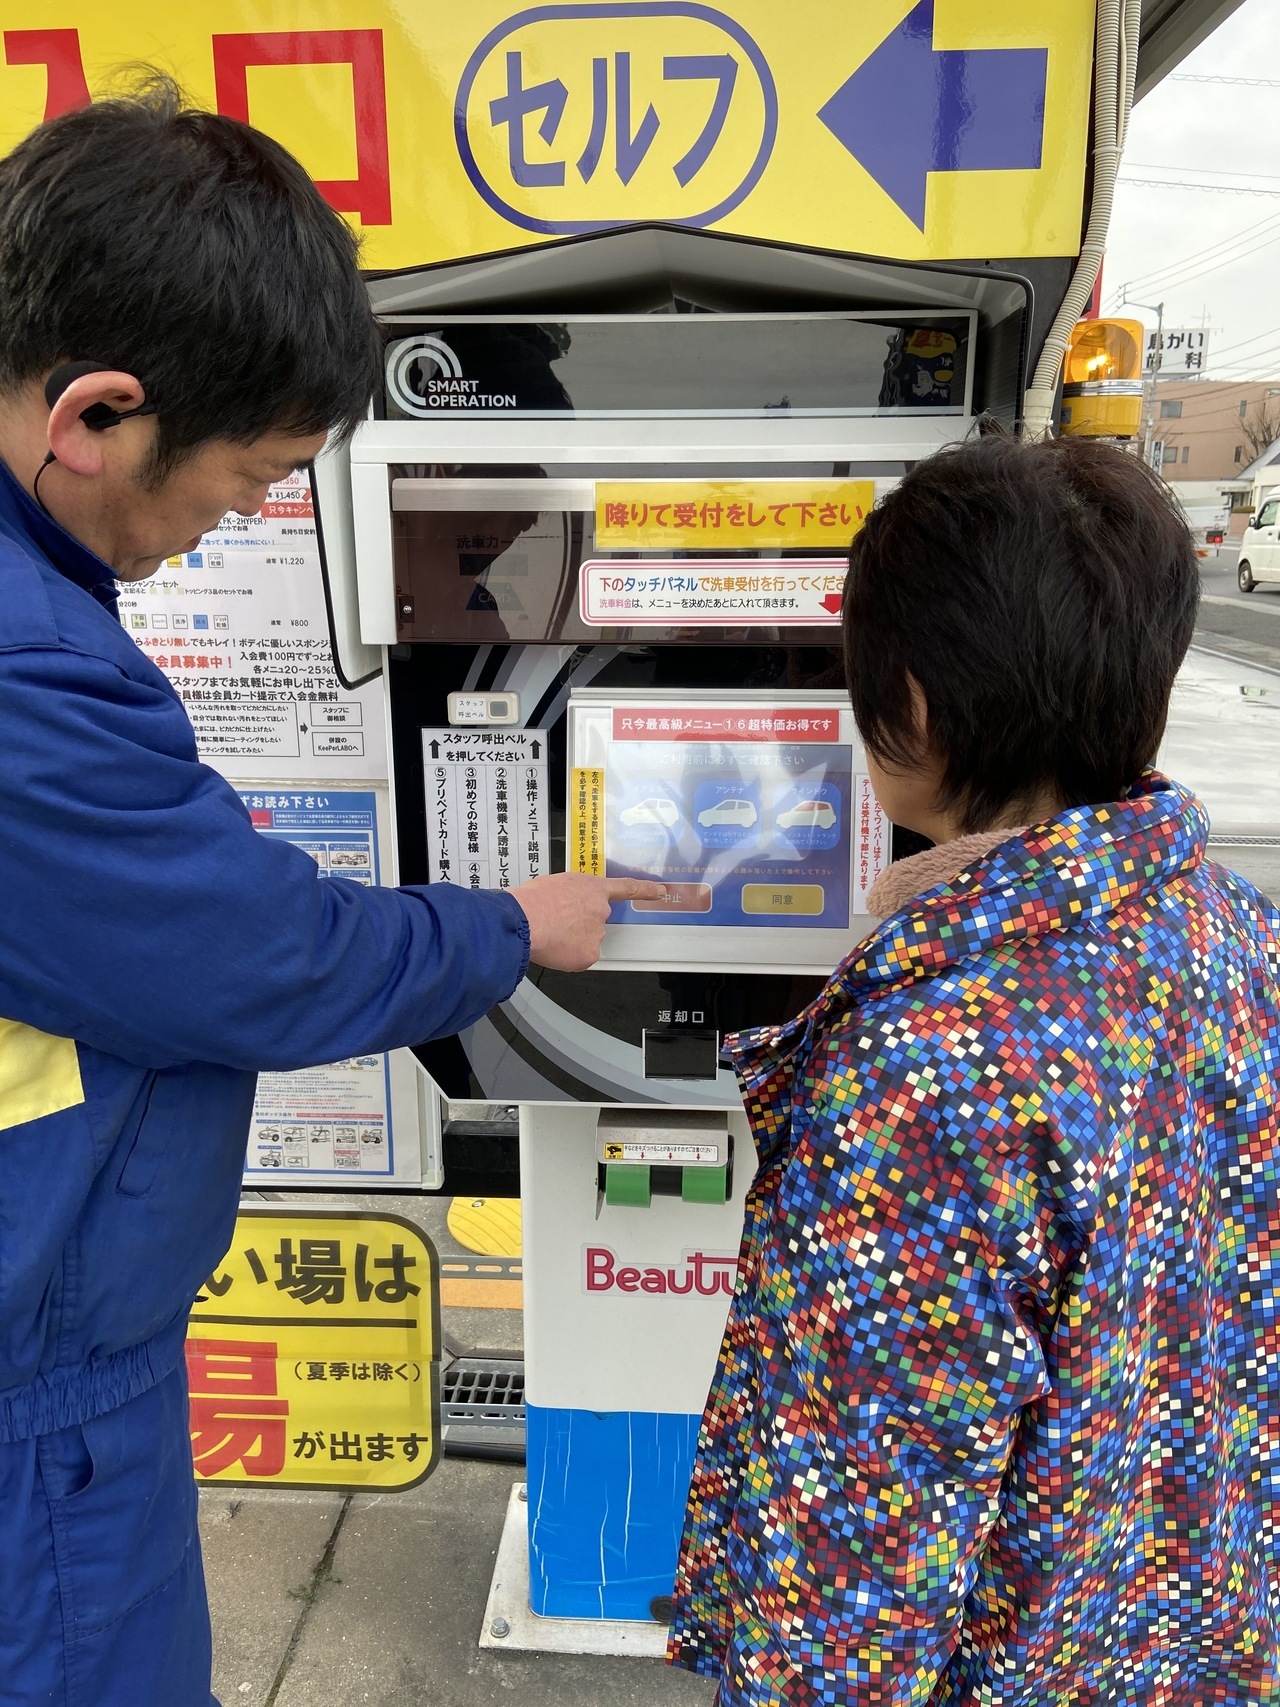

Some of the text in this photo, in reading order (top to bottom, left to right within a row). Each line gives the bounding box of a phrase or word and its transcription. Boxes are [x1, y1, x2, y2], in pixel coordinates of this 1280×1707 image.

[490, 51, 739, 188] セルフ
[428, 381, 479, 393] SMART
[428, 395, 517, 407] OPERATION
[605, 502, 863, 529] 降りて受付をして下さい
[478, 592, 511, 604] CARD
[599, 598, 800, 608] 洗車料金は、メニューを決めたあとに入れて頂きます。
[135, 637, 333, 648] らふきとり無しでもキレイ！ボディに優しいスポンジ
[147, 654, 232, 669] 会員募集中！
[443, 733, 527, 745] スタッフ呼出ベル
[446, 750, 526, 761] を押してください
[715, 786, 745, 794] アンテナ
[465, 767, 480, 853] ③初めてのお客様
[434, 767, 451, 883] ⑤プリペイドカード購入
[494, 767, 511, 891] ②洗車機乗入誘導してほ
[578, 771, 587, 874] を必ず確認の上、同意ボタンを押し
[591, 771, 599, 876] 左の「洗車をする前に必ずお読み下
[860, 779, 870, 891] テープは受付機下部にあります
[873, 797, 883, 883] たてワイパーはテープ
[772, 894, 793, 905] 同意
[657, 1010, 704, 1023] 返却口
[294, 1361, 421, 1382] （夏季は除く）
[293, 1431, 428, 1462] が出ます
